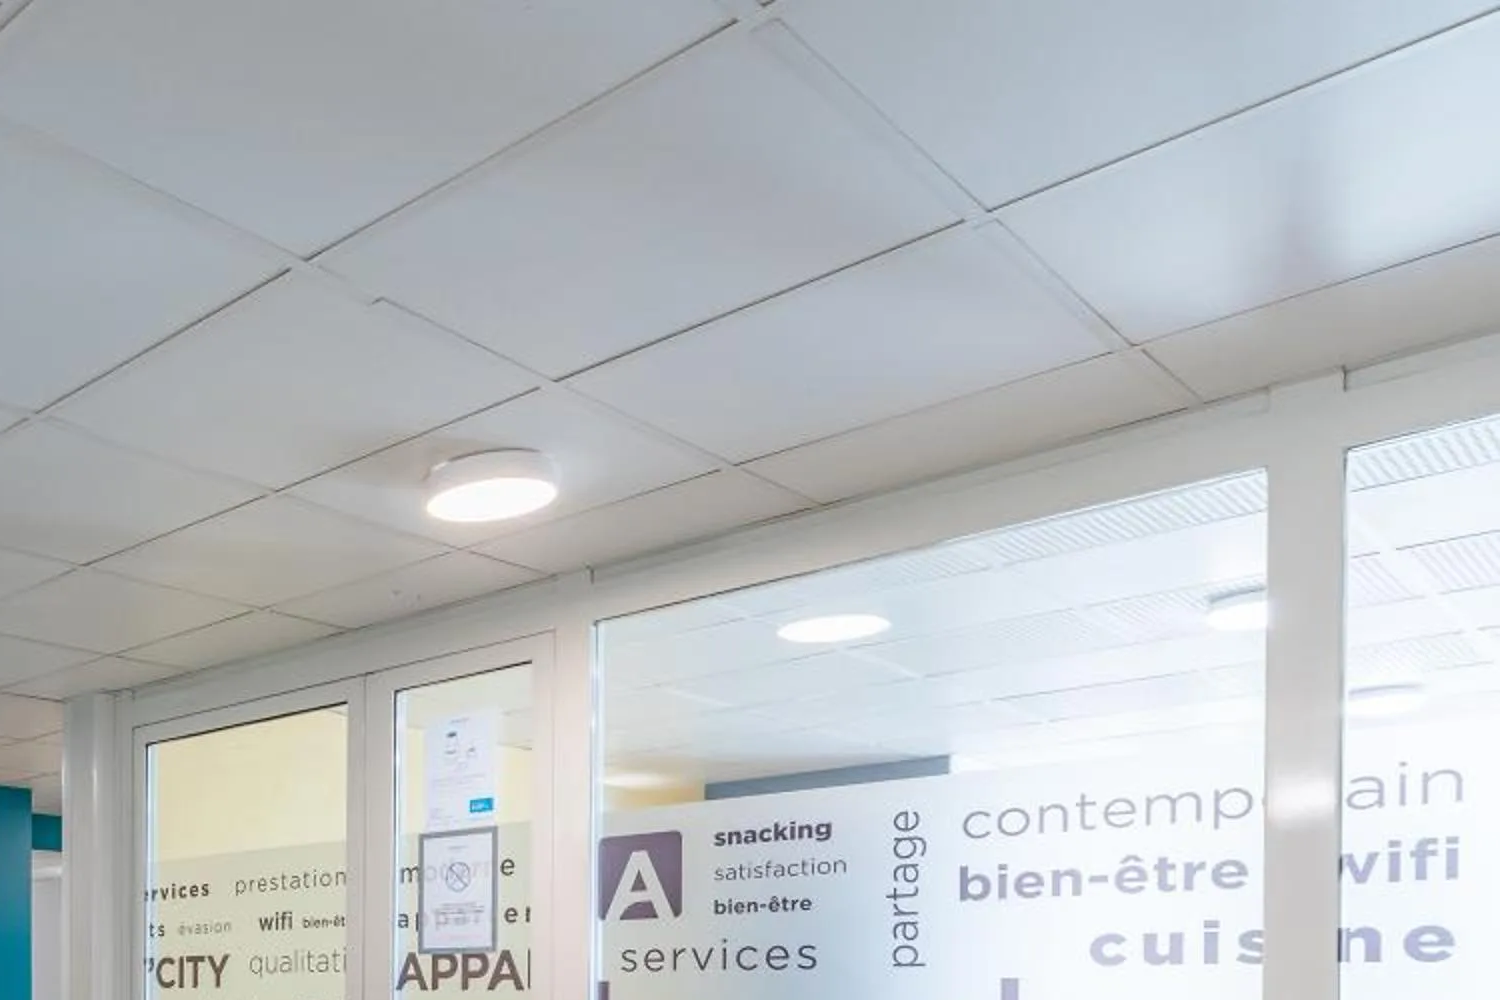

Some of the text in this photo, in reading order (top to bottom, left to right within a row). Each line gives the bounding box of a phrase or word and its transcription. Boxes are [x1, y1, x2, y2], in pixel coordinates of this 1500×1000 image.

[713, 819, 833, 848] snacking
[234, 869, 347, 896] prestation
[713, 858, 848, 882] satisfaction
[958, 836, 1460, 903] bien-être wifi
[886, 809, 927, 969] partage
[259, 910, 294, 932] wifi
[713, 897, 813, 915] bien-être
[620, 938, 819, 973] services
[1089, 919, 1457, 967] cuisne
[395, 949, 531, 992] APPA
